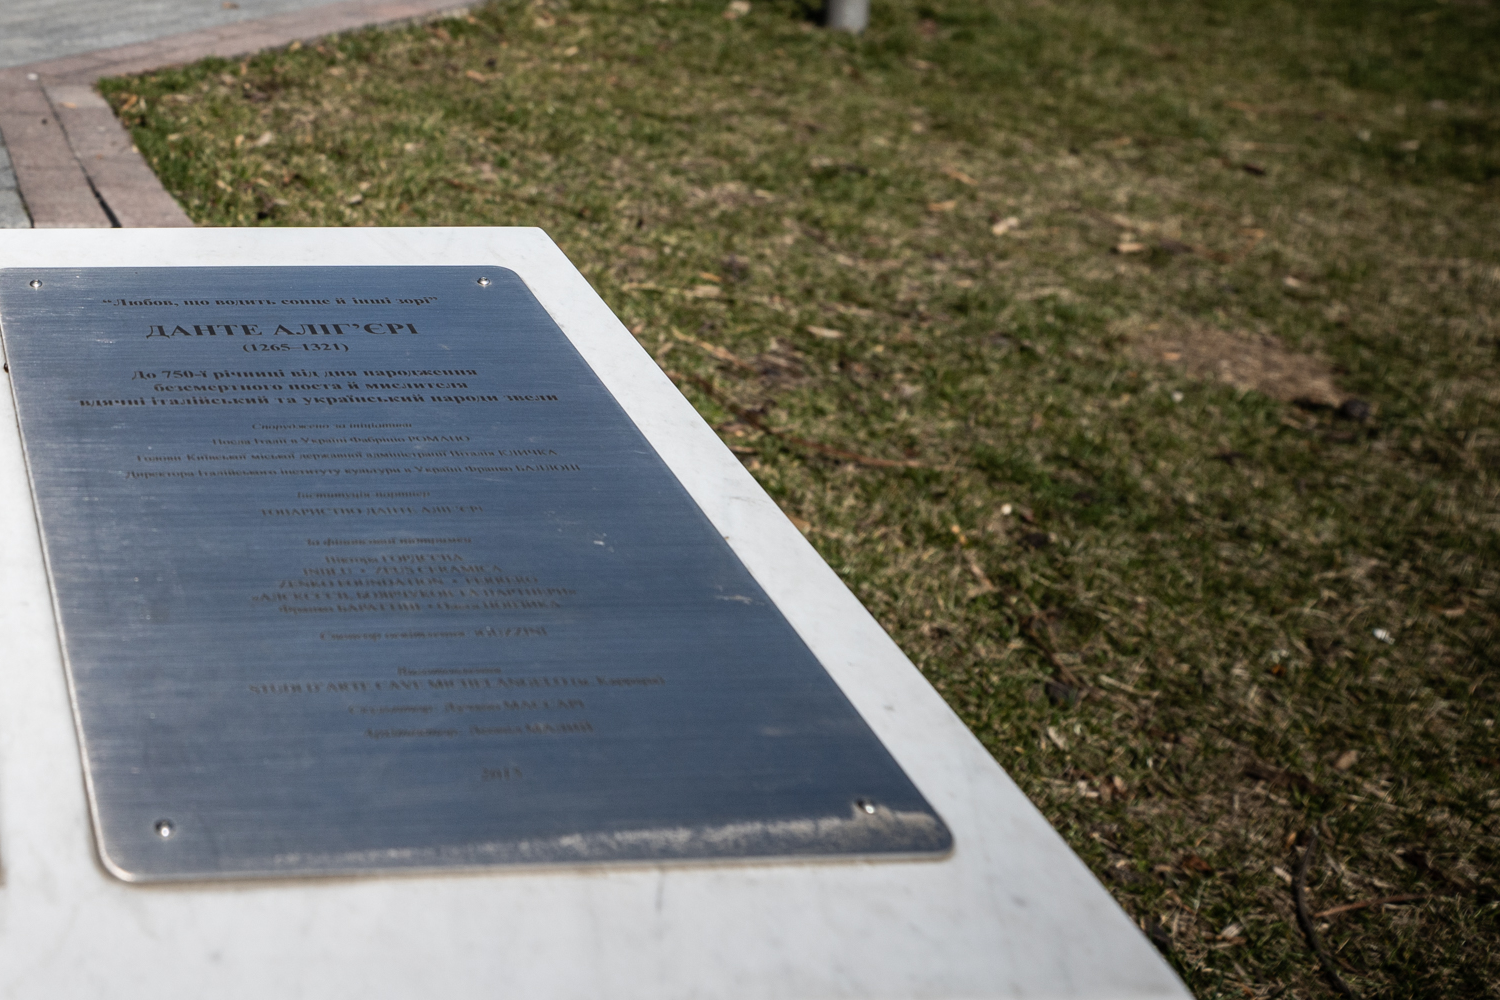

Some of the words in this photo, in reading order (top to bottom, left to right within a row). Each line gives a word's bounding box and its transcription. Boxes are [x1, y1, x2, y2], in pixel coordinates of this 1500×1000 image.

[336, 297, 346, 305] й
[353, 297, 391, 305] інші
[146, 324, 263, 338] ДАНТЕ
[132, 370, 156, 380] До
[162, 370, 207, 379] 750-ї
[214, 370, 284, 379] річниці
[291, 370, 320, 378] від
[363, 369, 477, 377] народження
[154, 384, 282, 392] безсмертного
[289, 383, 342, 391] поета
[348, 382, 359, 390] й
[365, 382, 468, 390] мислителя
[80, 399, 145, 407] вдячні
[151, 397, 269, 406] італійський
[276, 397, 297, 405] та
[303, 396, 424, 404] український
[430, 395, 498, 404] народи
[504, 394, 558, 402] звели
